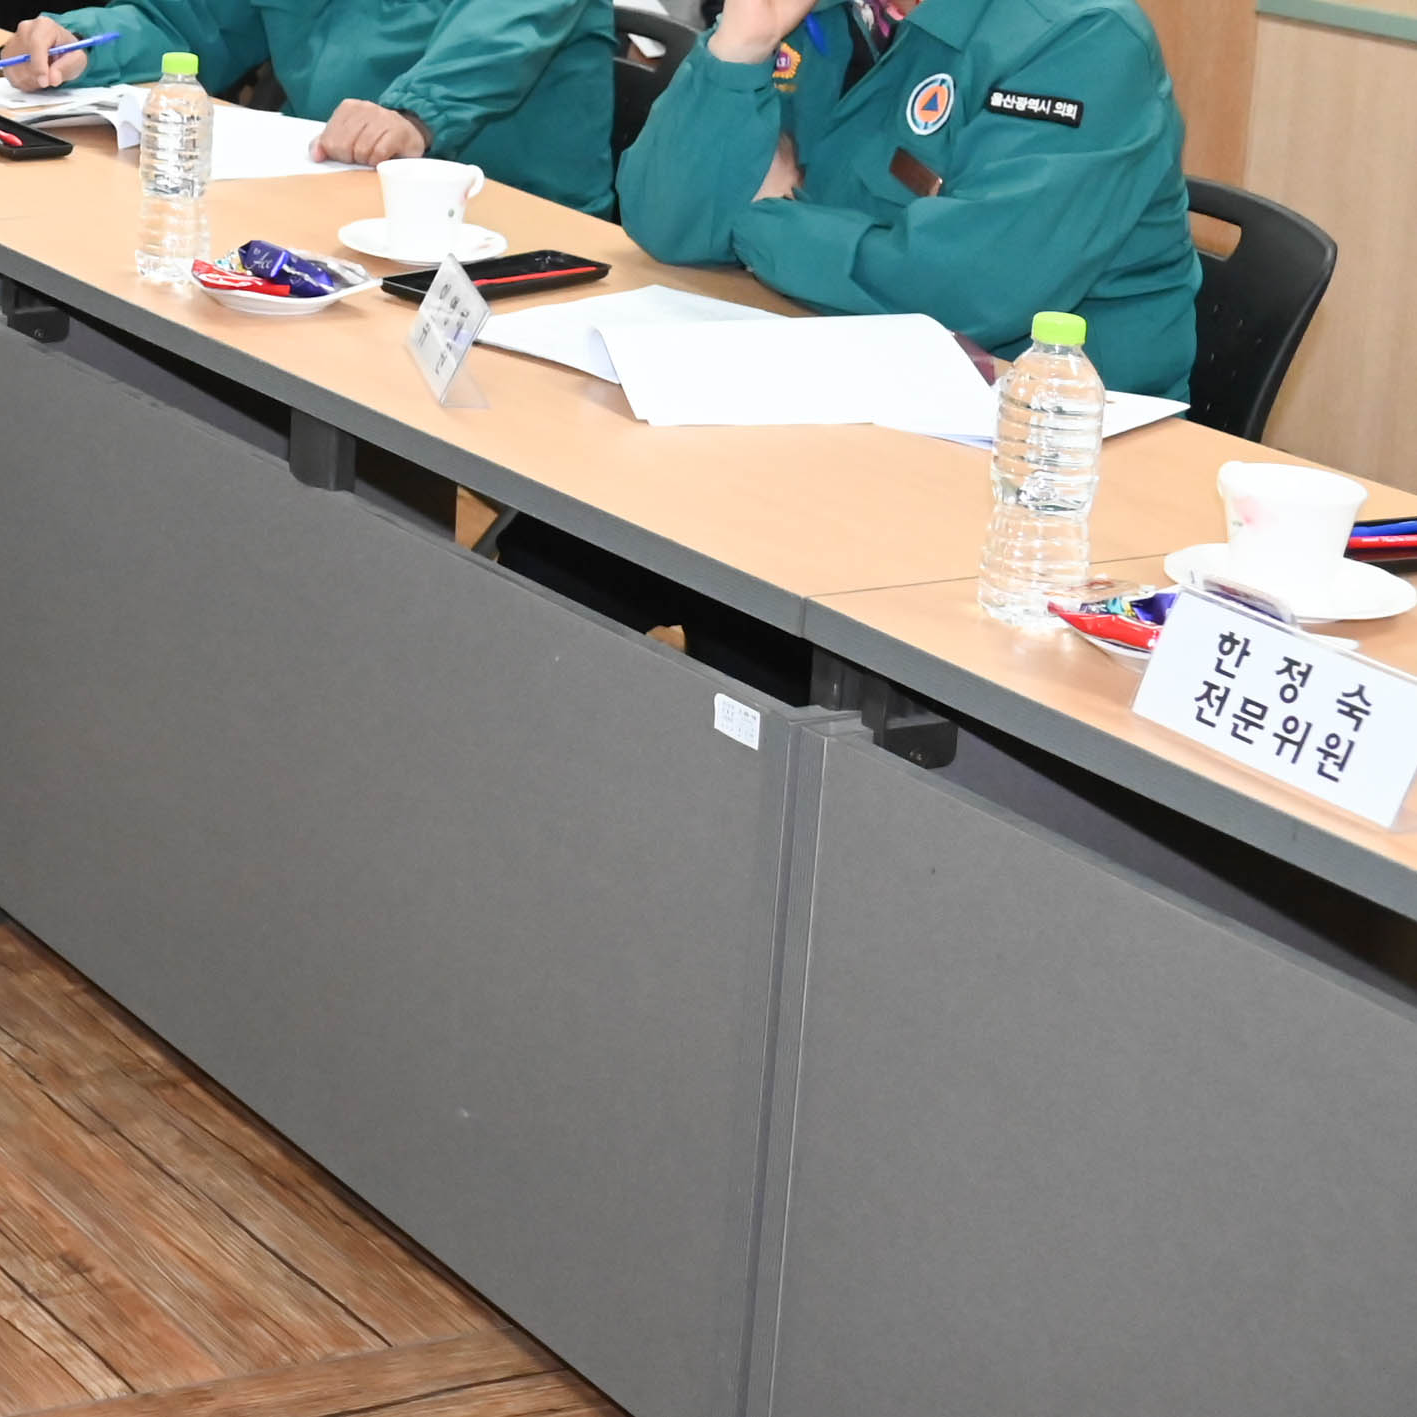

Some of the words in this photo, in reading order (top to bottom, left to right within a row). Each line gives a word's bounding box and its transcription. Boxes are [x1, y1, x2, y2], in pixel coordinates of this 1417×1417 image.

[990, 91, 1052, 115] 울산광역시
[1053, 100, 1079, 121] 의회
[1193, 680, 1356, 783] 전문위원
